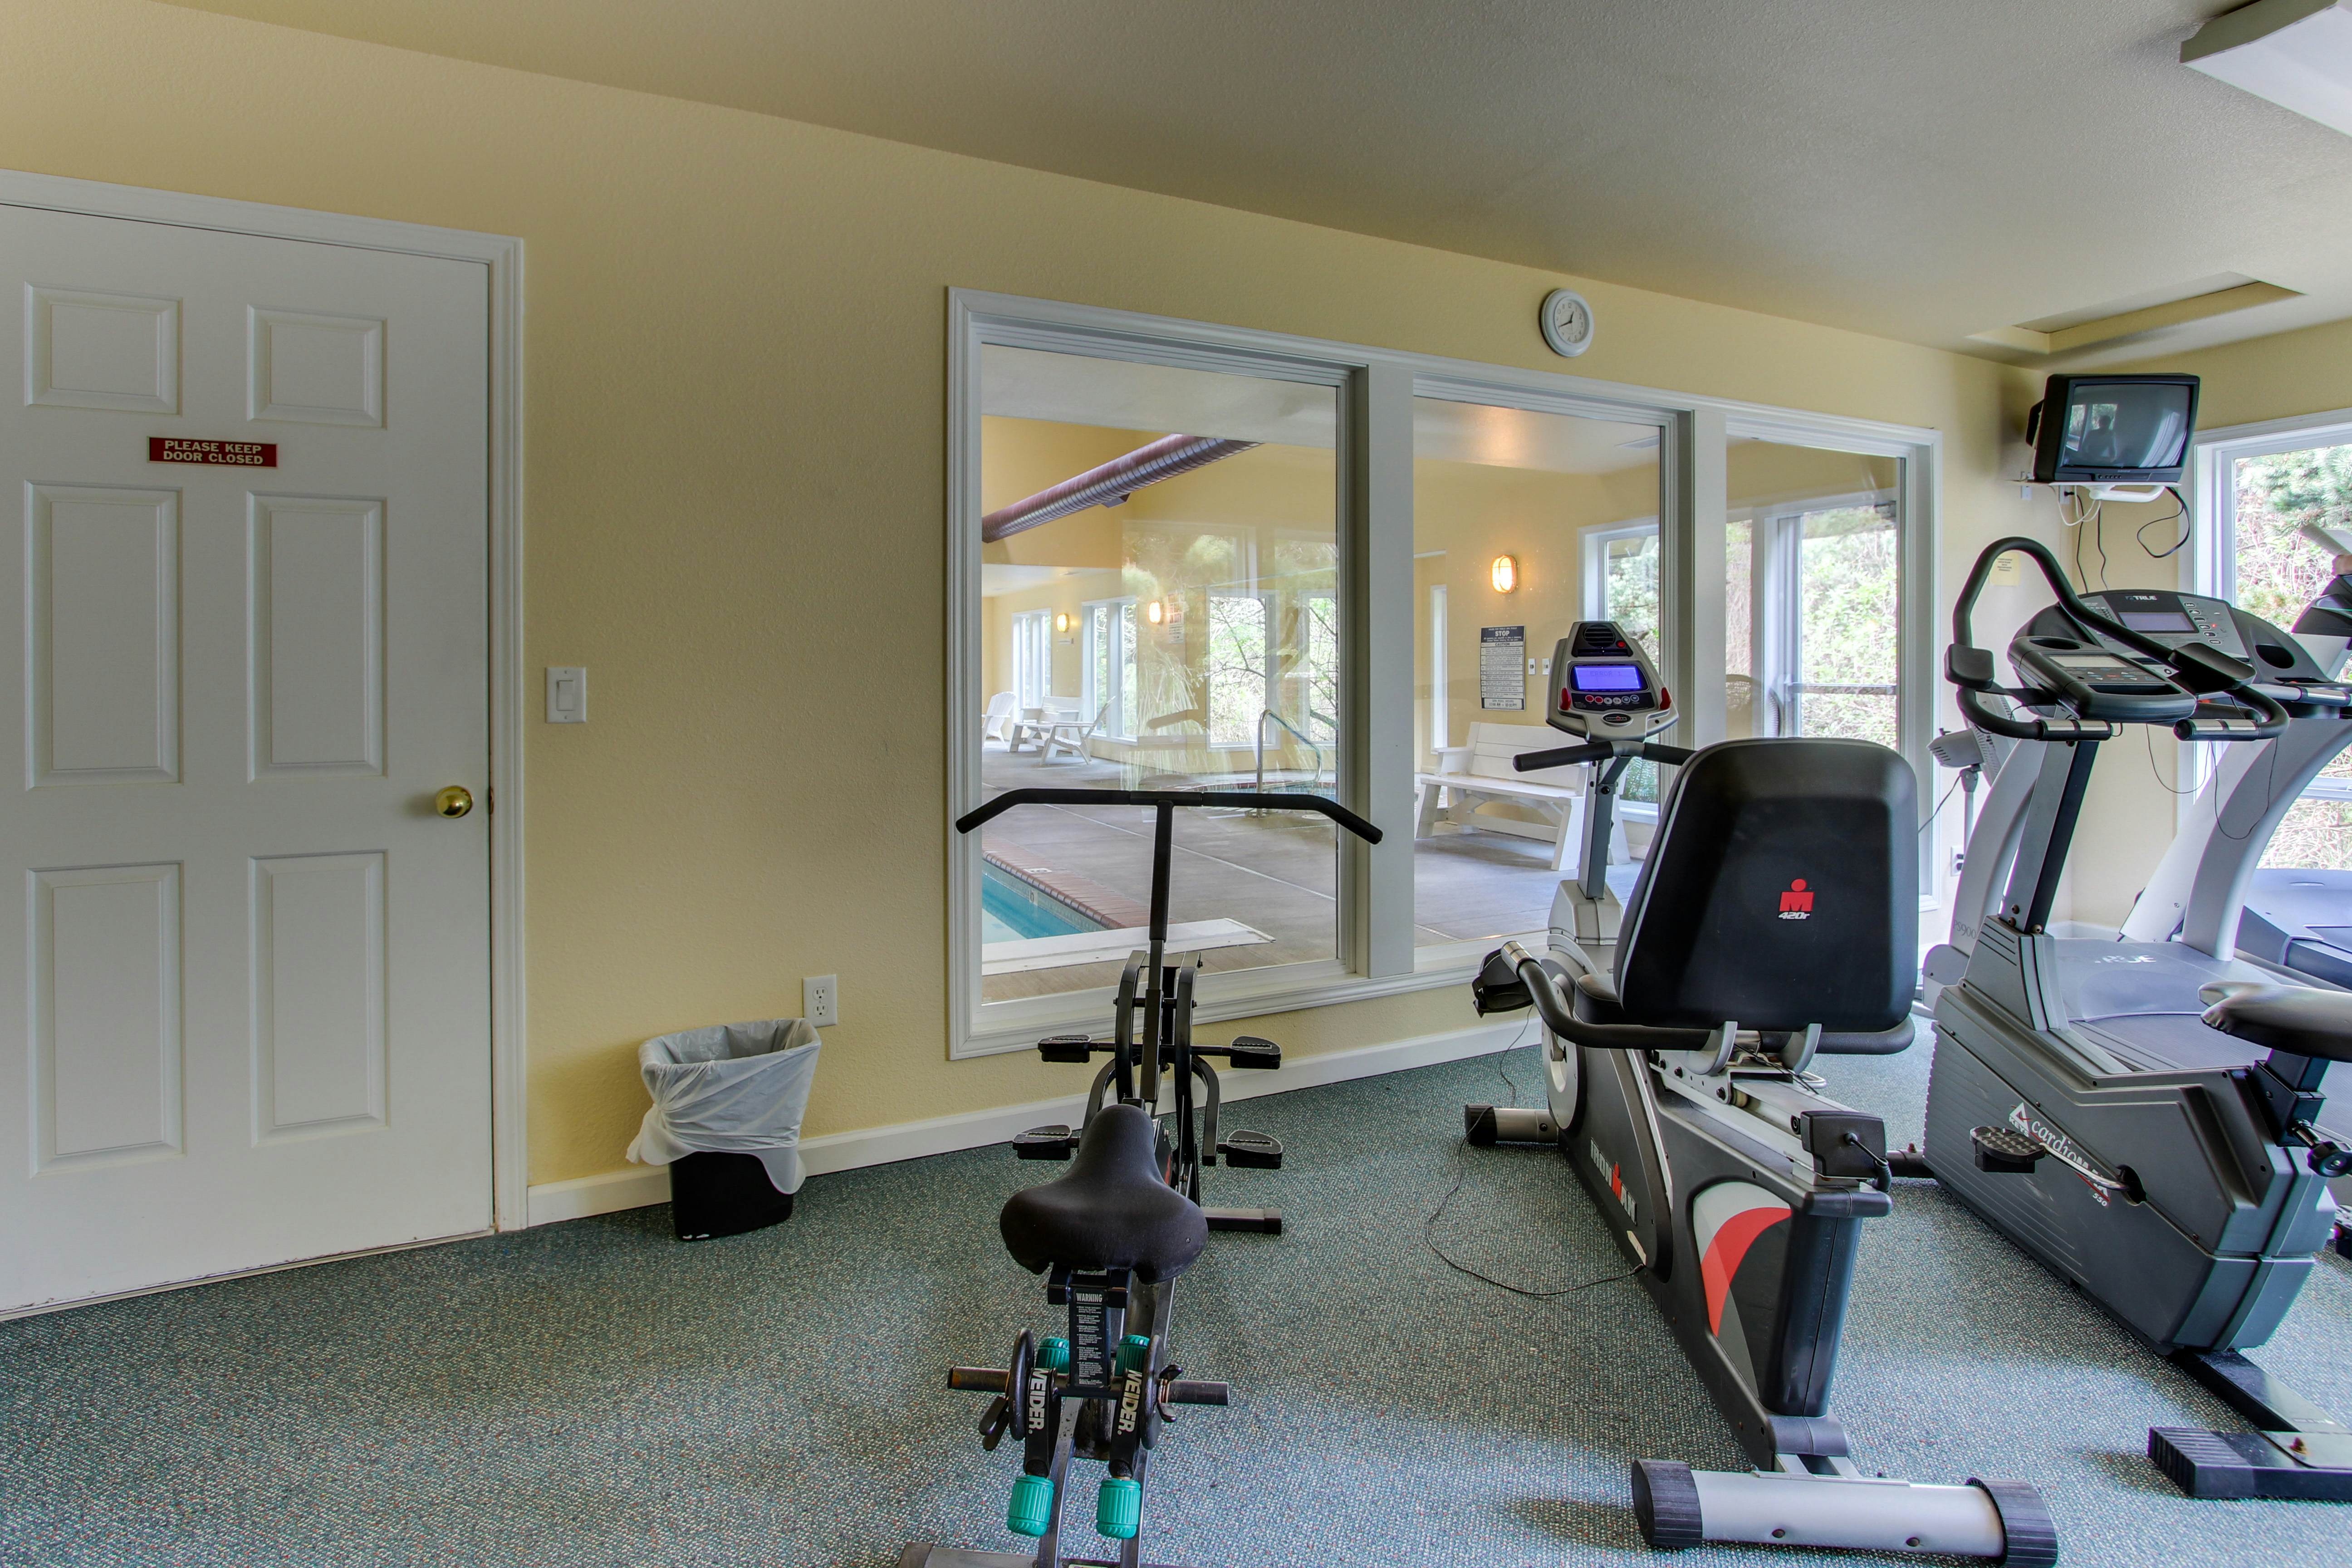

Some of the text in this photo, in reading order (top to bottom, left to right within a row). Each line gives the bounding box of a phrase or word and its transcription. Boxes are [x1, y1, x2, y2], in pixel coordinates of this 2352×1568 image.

[165, 440, 262, 454] PLEASE KEEP
[163, 451, 264, 465] DOOR CLOSED
[1779, 911, 1810, 920] 420r
[2009, 1116, 2029, 1137] KEYS
[1591, 1137, 1637, 1225] IRONMAN
[2092, 1192, 2108, 1207] 550
[1076, 1293, 1102, 1303] WARNING
[1029, 1368, 1050, 1430] WEIDER
[1118, 1369, 1143, 1432] WEIDER
